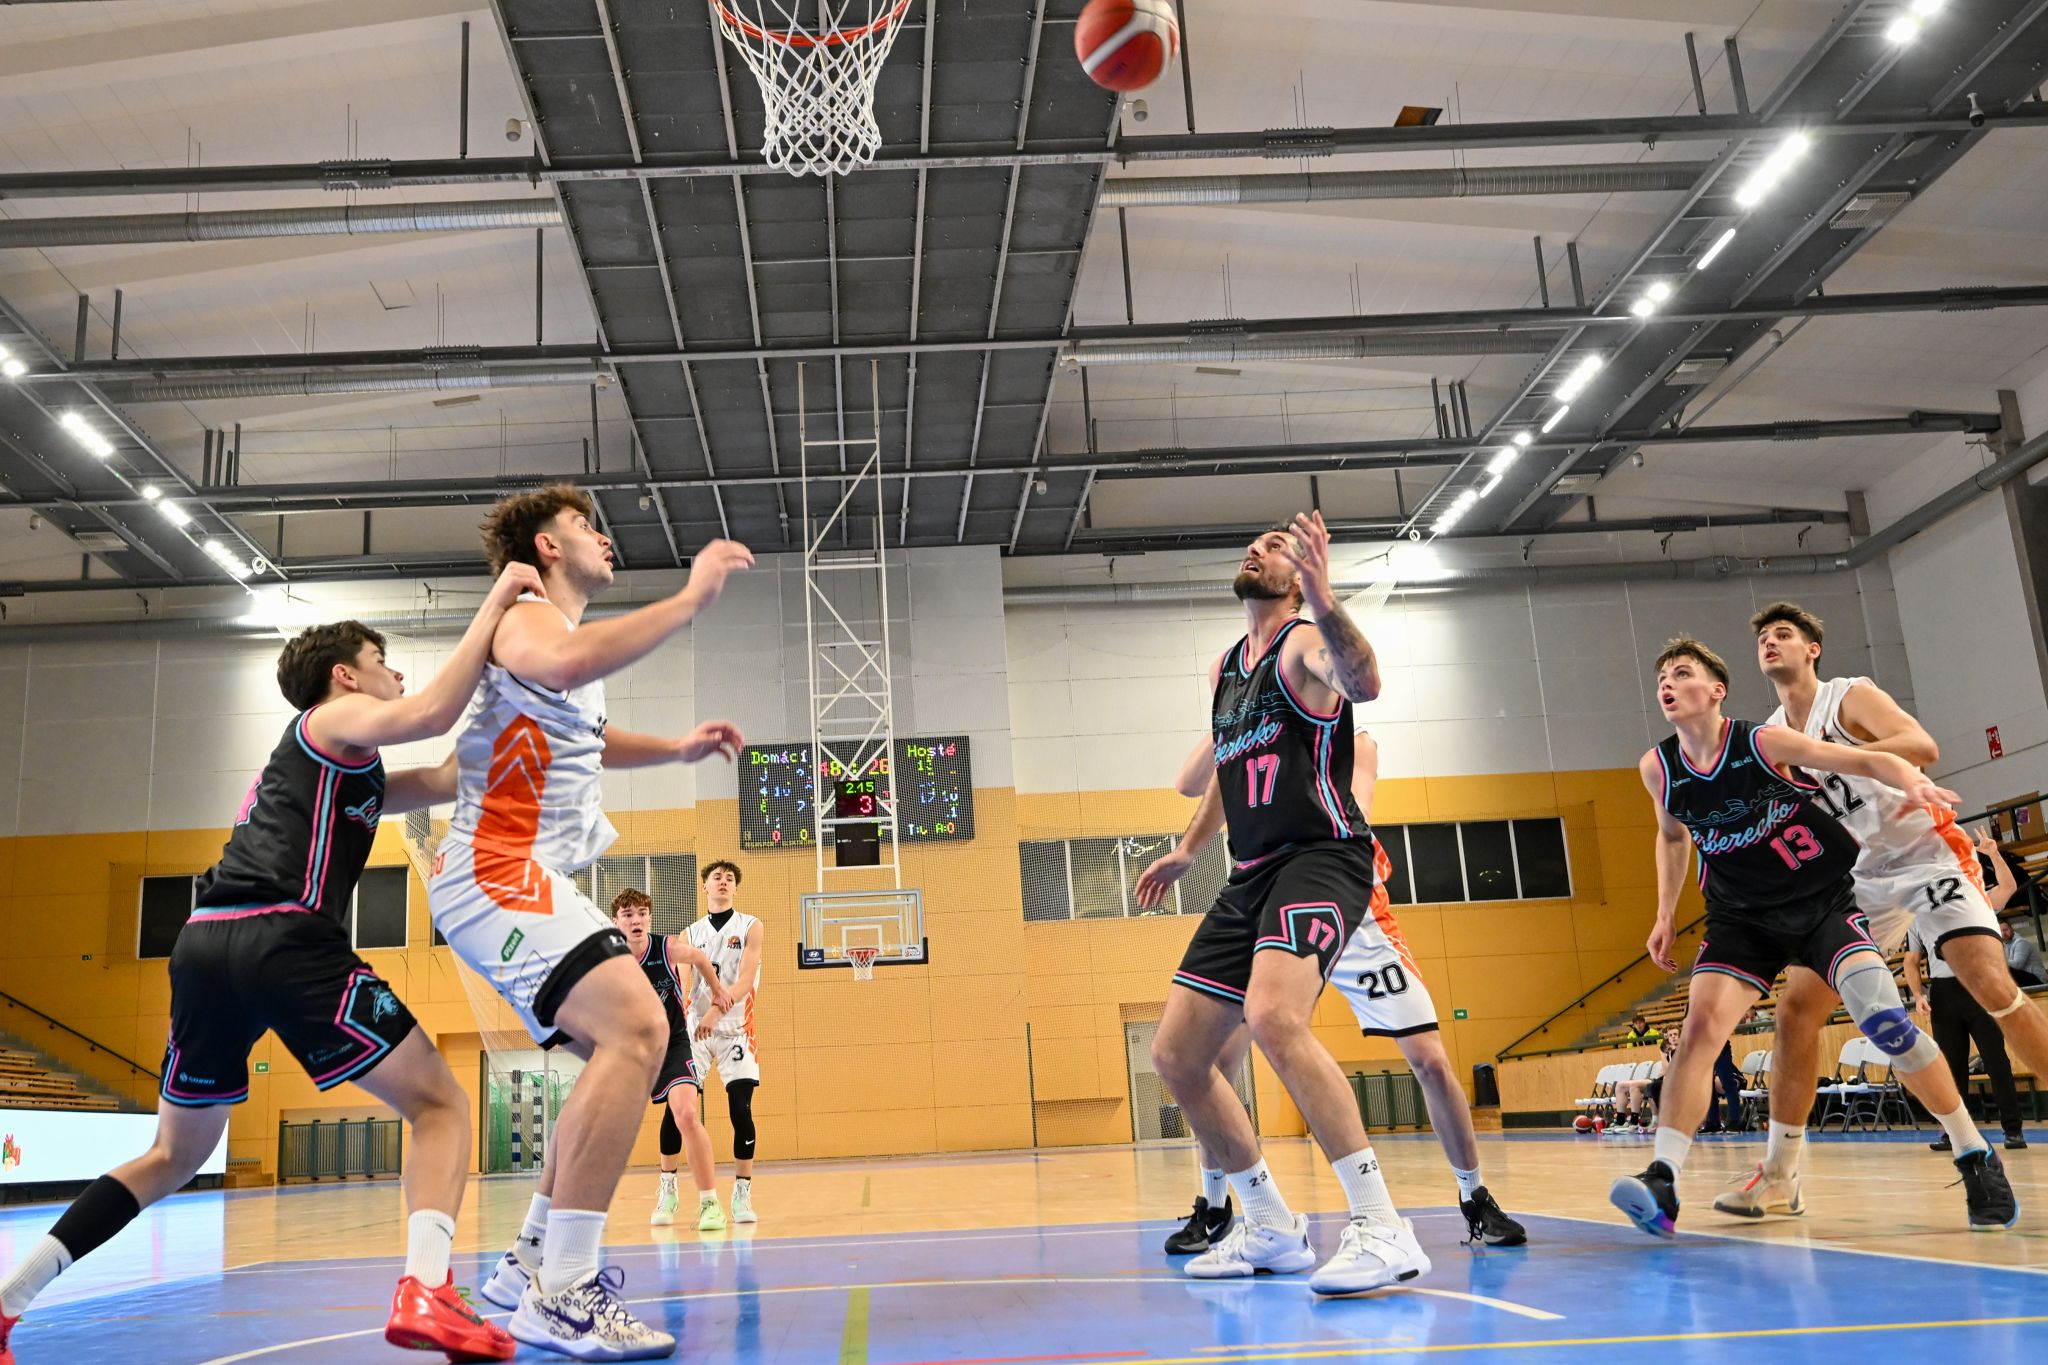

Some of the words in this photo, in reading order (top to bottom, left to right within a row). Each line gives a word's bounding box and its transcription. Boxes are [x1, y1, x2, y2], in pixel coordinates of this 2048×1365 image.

[907, 743, 957, 757] Hosté
[1246, 753, 1280, 808] 17
[1815, 771, 1867, 821] 12
[859, 795, 873, 813] 3
[1769, 824, 1824, 870] 13
[1926, 877, 1966, 912] 12
[1307, 918, 1336, 951] 17
[1356, 961, 1409, 1001] 20
[732, 1045, 744, 1061] 3
[1249, 1170, 1268, 1187] 23
[1358, 1160, 1378, 1175] 23
